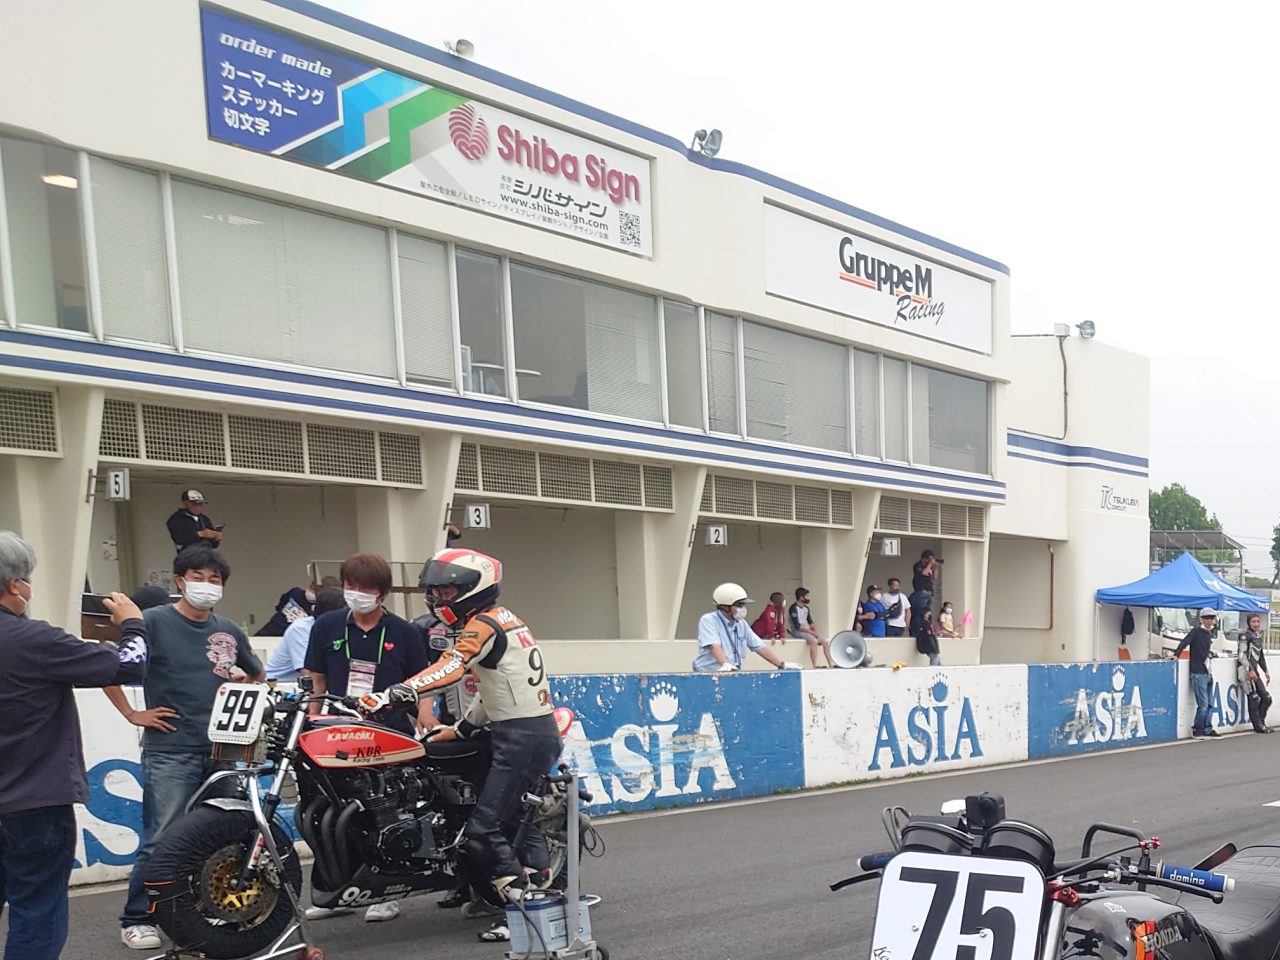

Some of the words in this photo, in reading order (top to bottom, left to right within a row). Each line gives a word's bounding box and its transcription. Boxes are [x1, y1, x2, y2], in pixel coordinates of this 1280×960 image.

[219, 33, 277, 59] order
[281, 53, 333, 78] made
[220, 60, 325, 105] カーマーキング
[222, 84, 298, 117] ステッカー
[223, 107, 271, 136] 切文字
[497, 124, 580, 183] Shiba
[585, 154, 640, 205] Sign
[500, 193, 609, 231] www.shiba-sign.com
[513, 179, 608, 218] シバサイン
[894, 294, 945, 326] Racing
[114, 474, 121, 495] 5
[474, 507, 482, 526] 3
[714, 528, 721, 544] 2
[889, 541, 895, 554] 1
[216, 689, 260, 733] 99
[1067, 685, 1148, 746] ASIA
[869, 695, 985, 772] ASIA
[558, 711, 737, 807] ASIA
[1169, 869, 1205, 886] domino
[1145, 925, 1182, 953] HONDA
